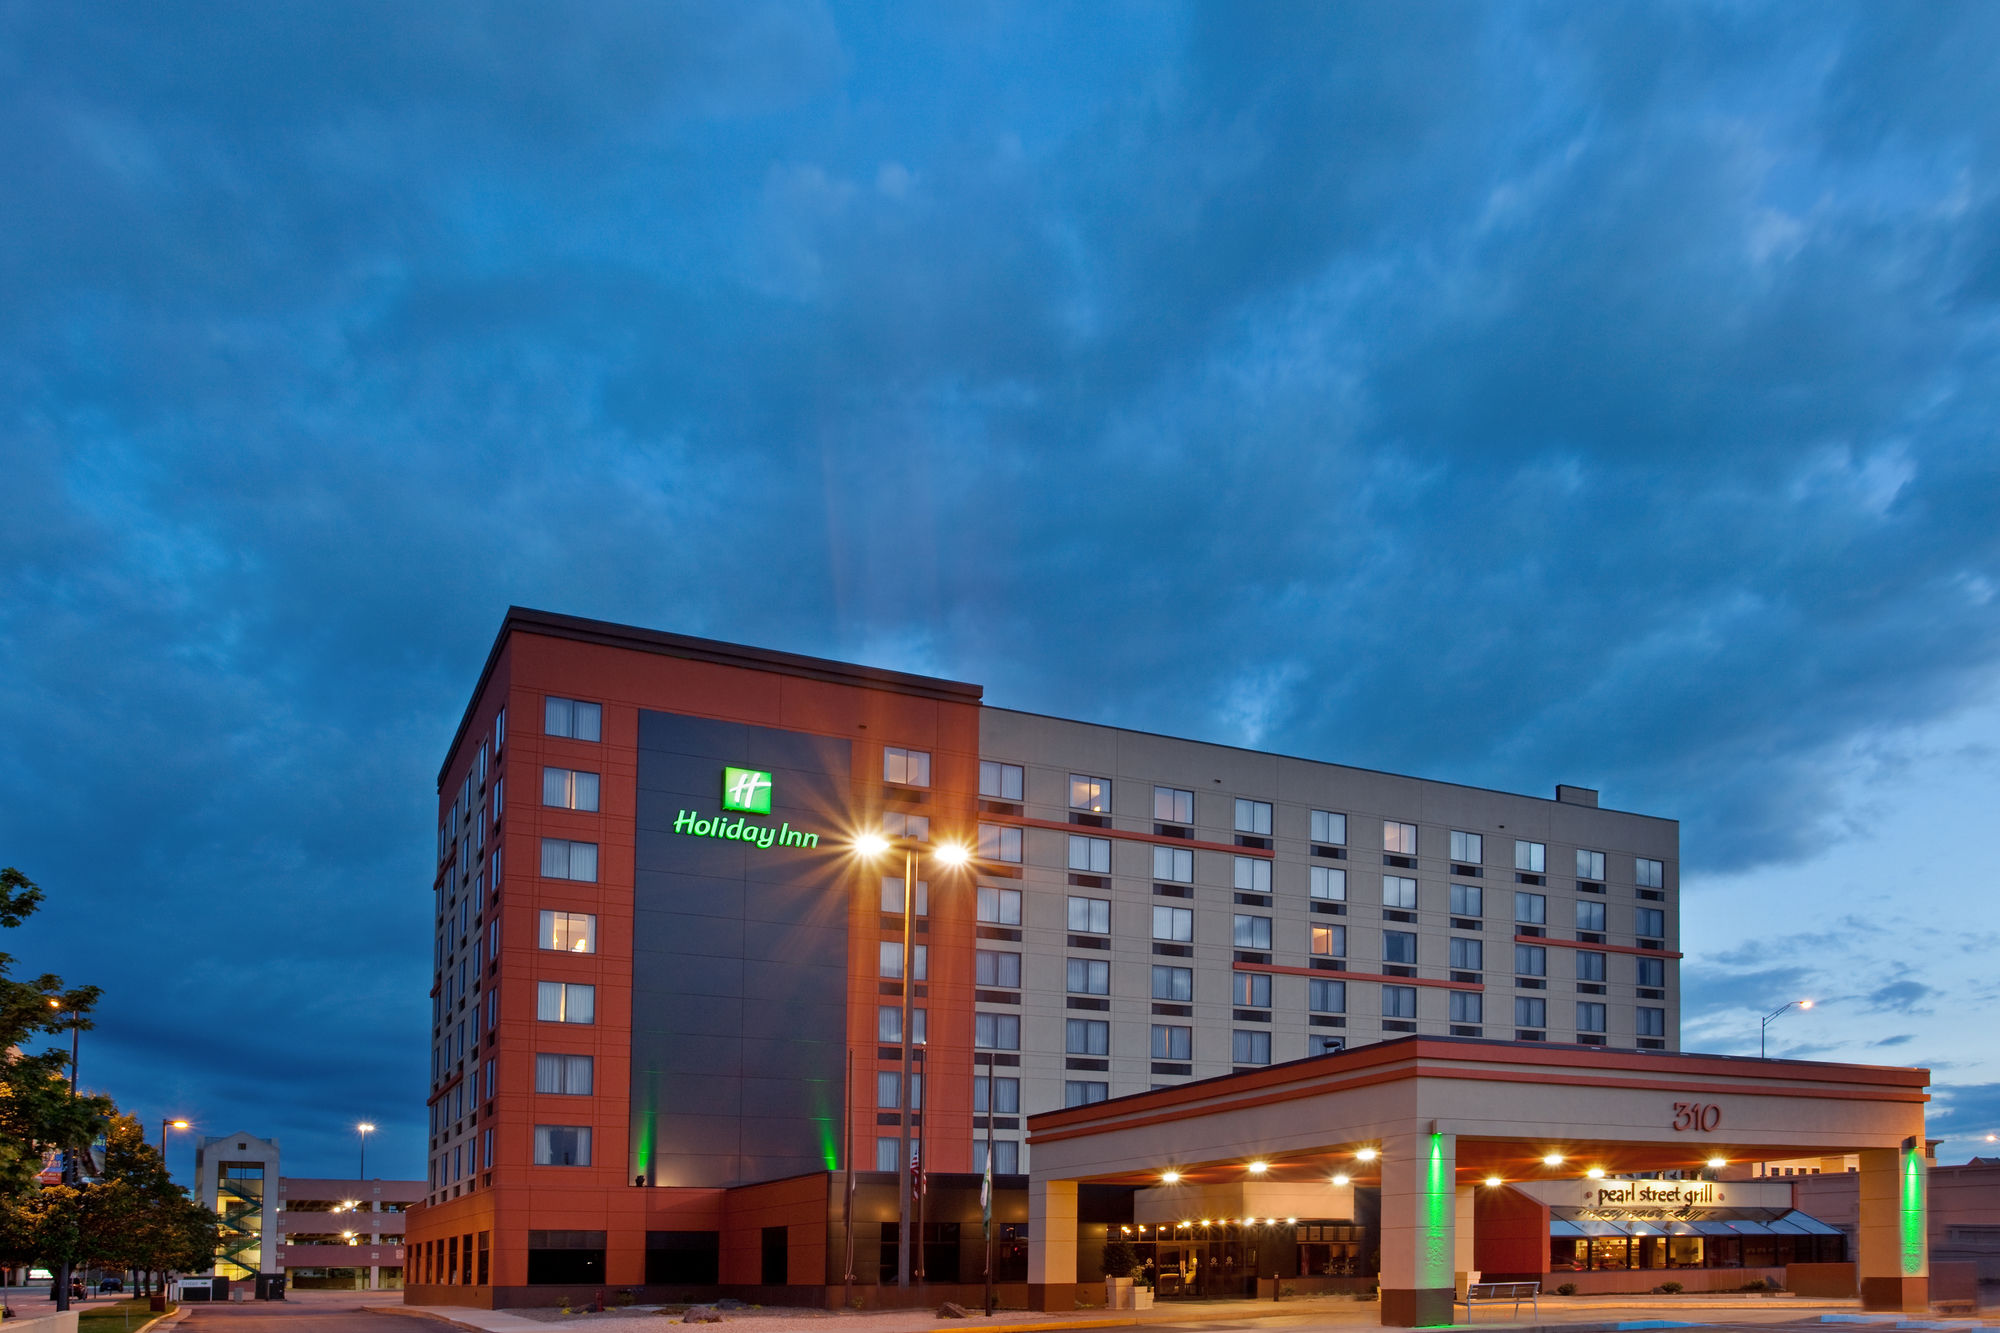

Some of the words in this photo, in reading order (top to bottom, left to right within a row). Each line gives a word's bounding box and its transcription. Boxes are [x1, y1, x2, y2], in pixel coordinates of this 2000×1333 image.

[729, 773, 771, 808] H
[673, 809, 776, 849] Holiday
[779, 823, 819, 849] Inn
[1673, 1102, 1721, 1132] 310
[1598, 1183, 1635, 1206] pearl
[1640, 1186, 1681, 1202] street
[1684, 1184, 1712, 1207] grill
